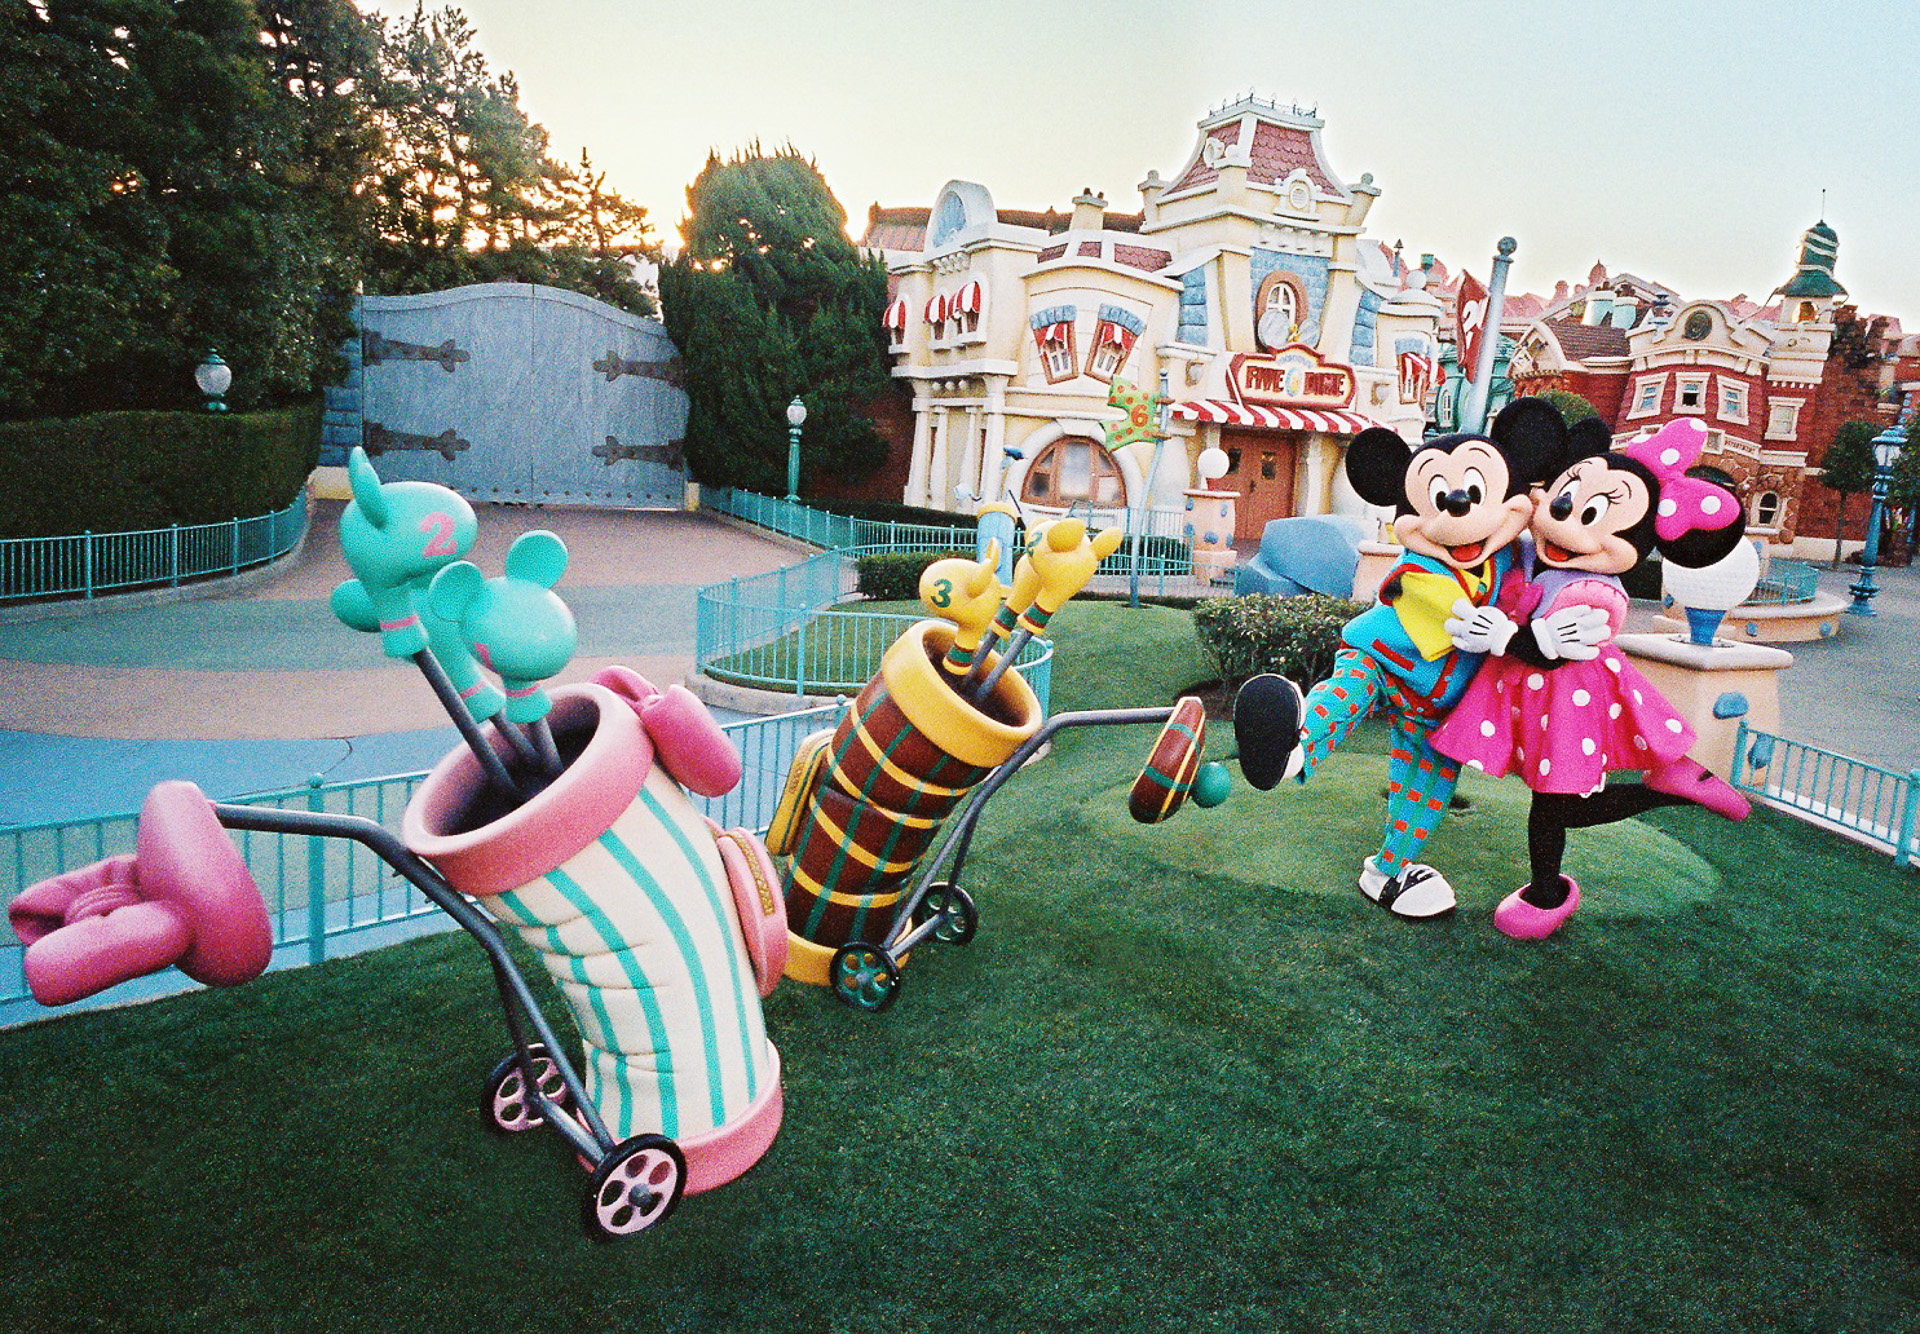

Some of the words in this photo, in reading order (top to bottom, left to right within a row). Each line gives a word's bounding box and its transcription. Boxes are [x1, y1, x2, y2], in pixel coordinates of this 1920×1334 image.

[1246, 365, 1285, 393] FIVE
[1303, 371, 1345, 397] DIME
[1131, 404, 1149, 427] 6
[419, 512, 459, 558] 2
[930, 578, 953, 608] 3
